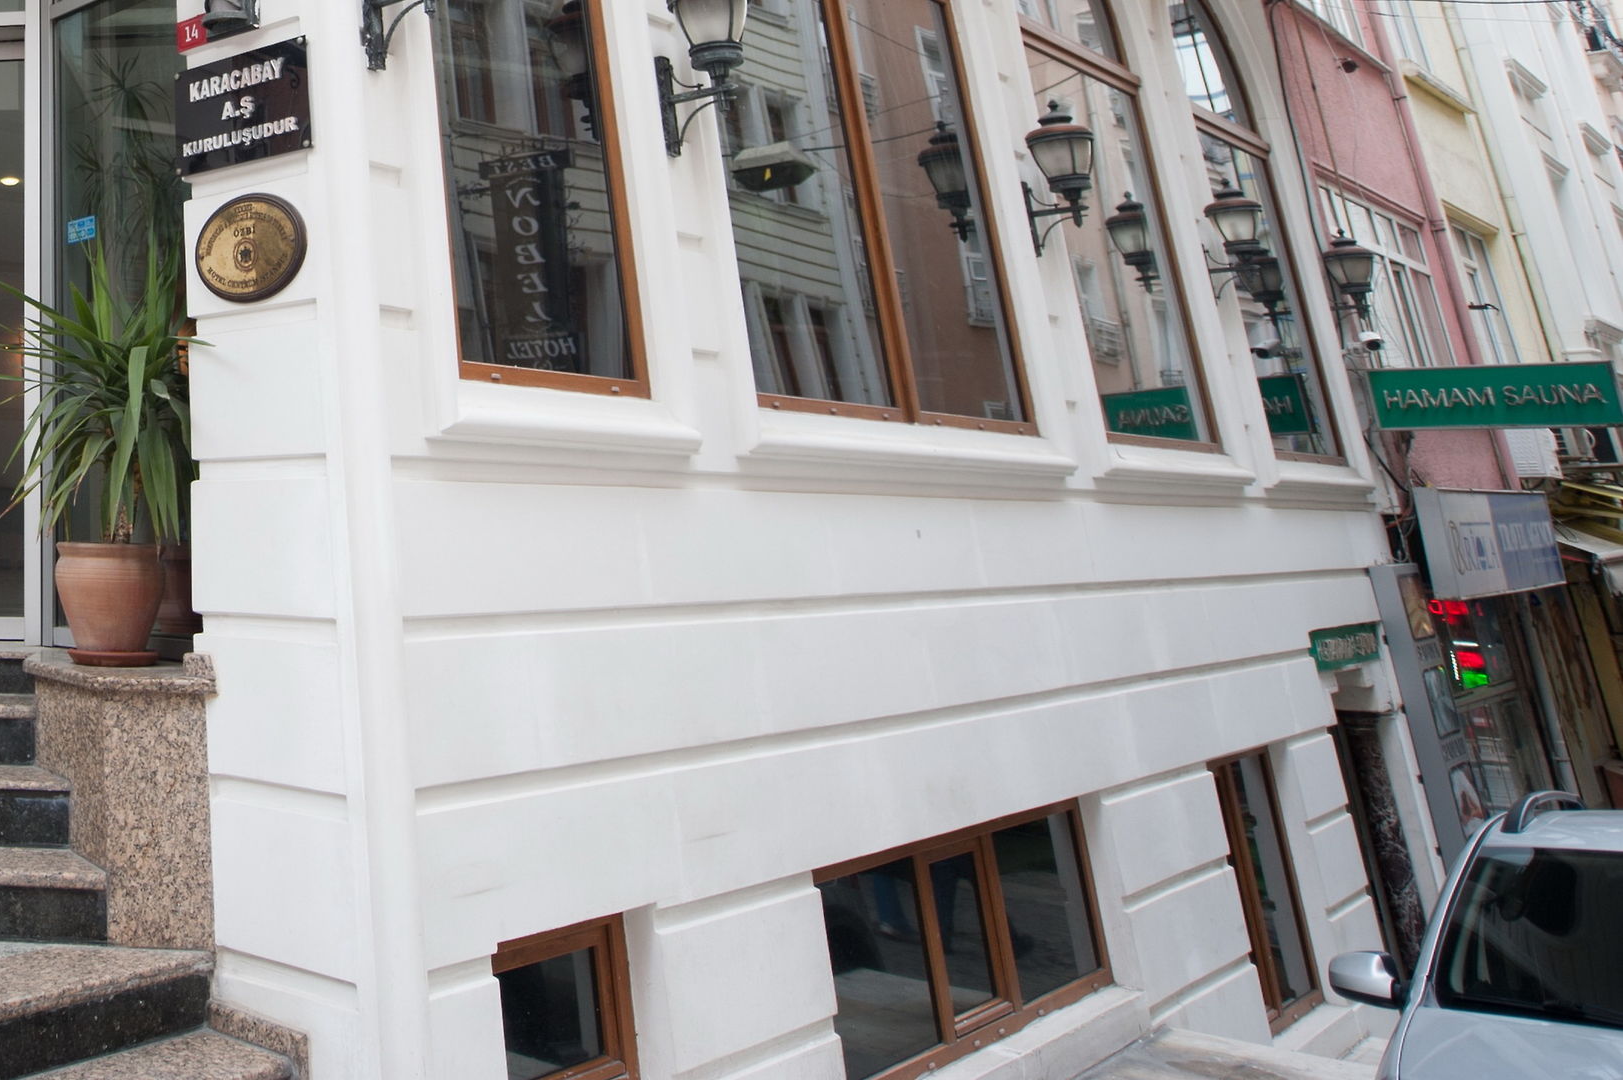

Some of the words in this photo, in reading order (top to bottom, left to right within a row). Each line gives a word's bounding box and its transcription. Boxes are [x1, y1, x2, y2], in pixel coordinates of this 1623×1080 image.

[185, 23, 199, 43] 14
[189, 57, 285, 102] KARACABAY
[221, 95, 255, 119] A.Ş
[182, 116, 299, 157] KURULUŞUDUR
[1383, 386, 1496, 409] HAMAM
[1502, 383, 1609, 406] SAUNA
